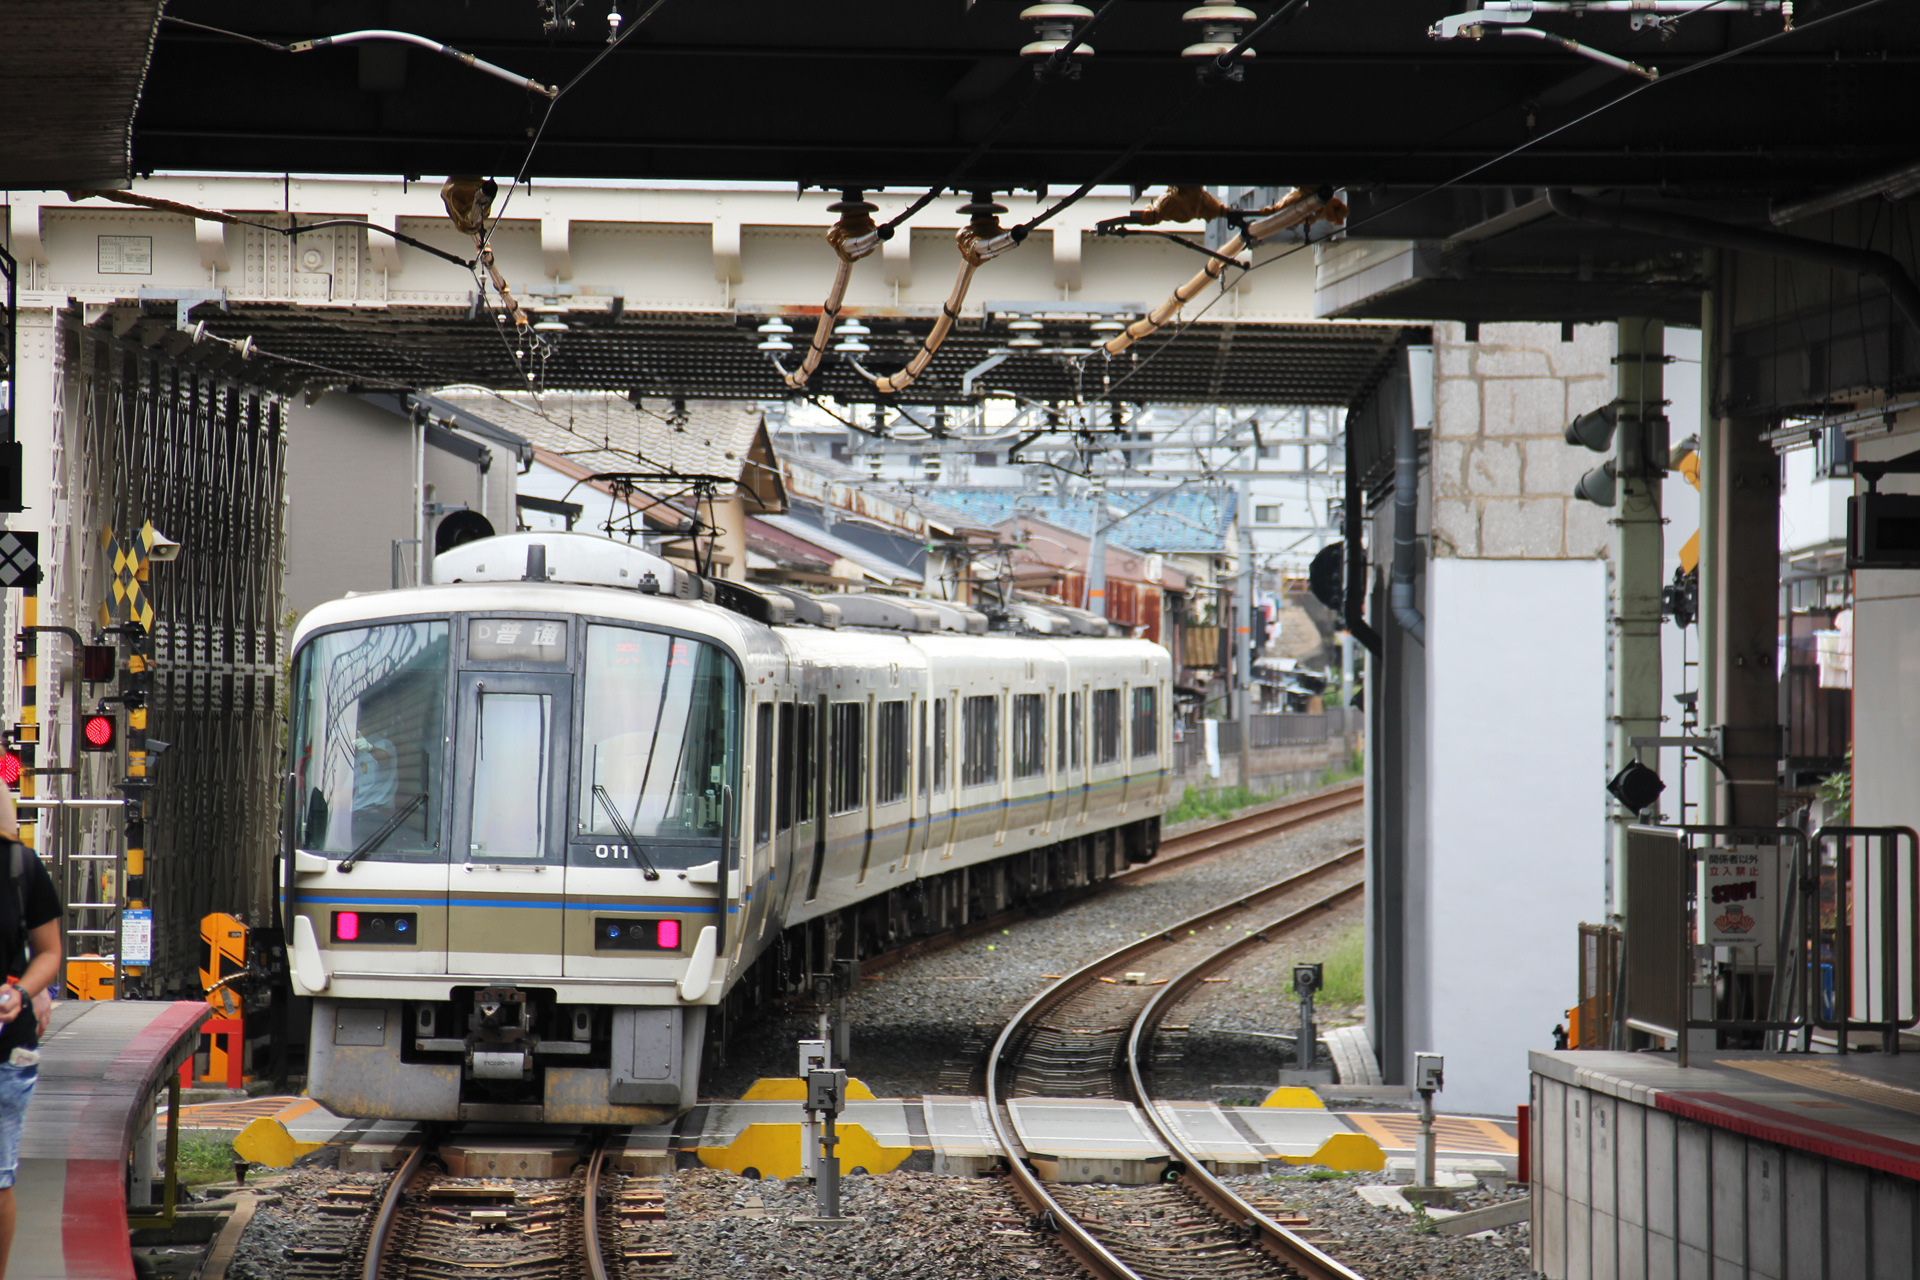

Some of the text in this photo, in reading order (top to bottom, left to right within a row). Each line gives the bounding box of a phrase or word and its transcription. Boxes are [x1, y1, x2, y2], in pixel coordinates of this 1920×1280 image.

[478, 622, 559, 646] D 普通
[615, 642, 690, 666] 奈良
[595, 845, 629, 859] 011
[1709, 854, 1759, 865] 関係者以外
[1709, 866, 1759, 877] 立入禁止
[1711, 881, 1757, 904] STOP!
